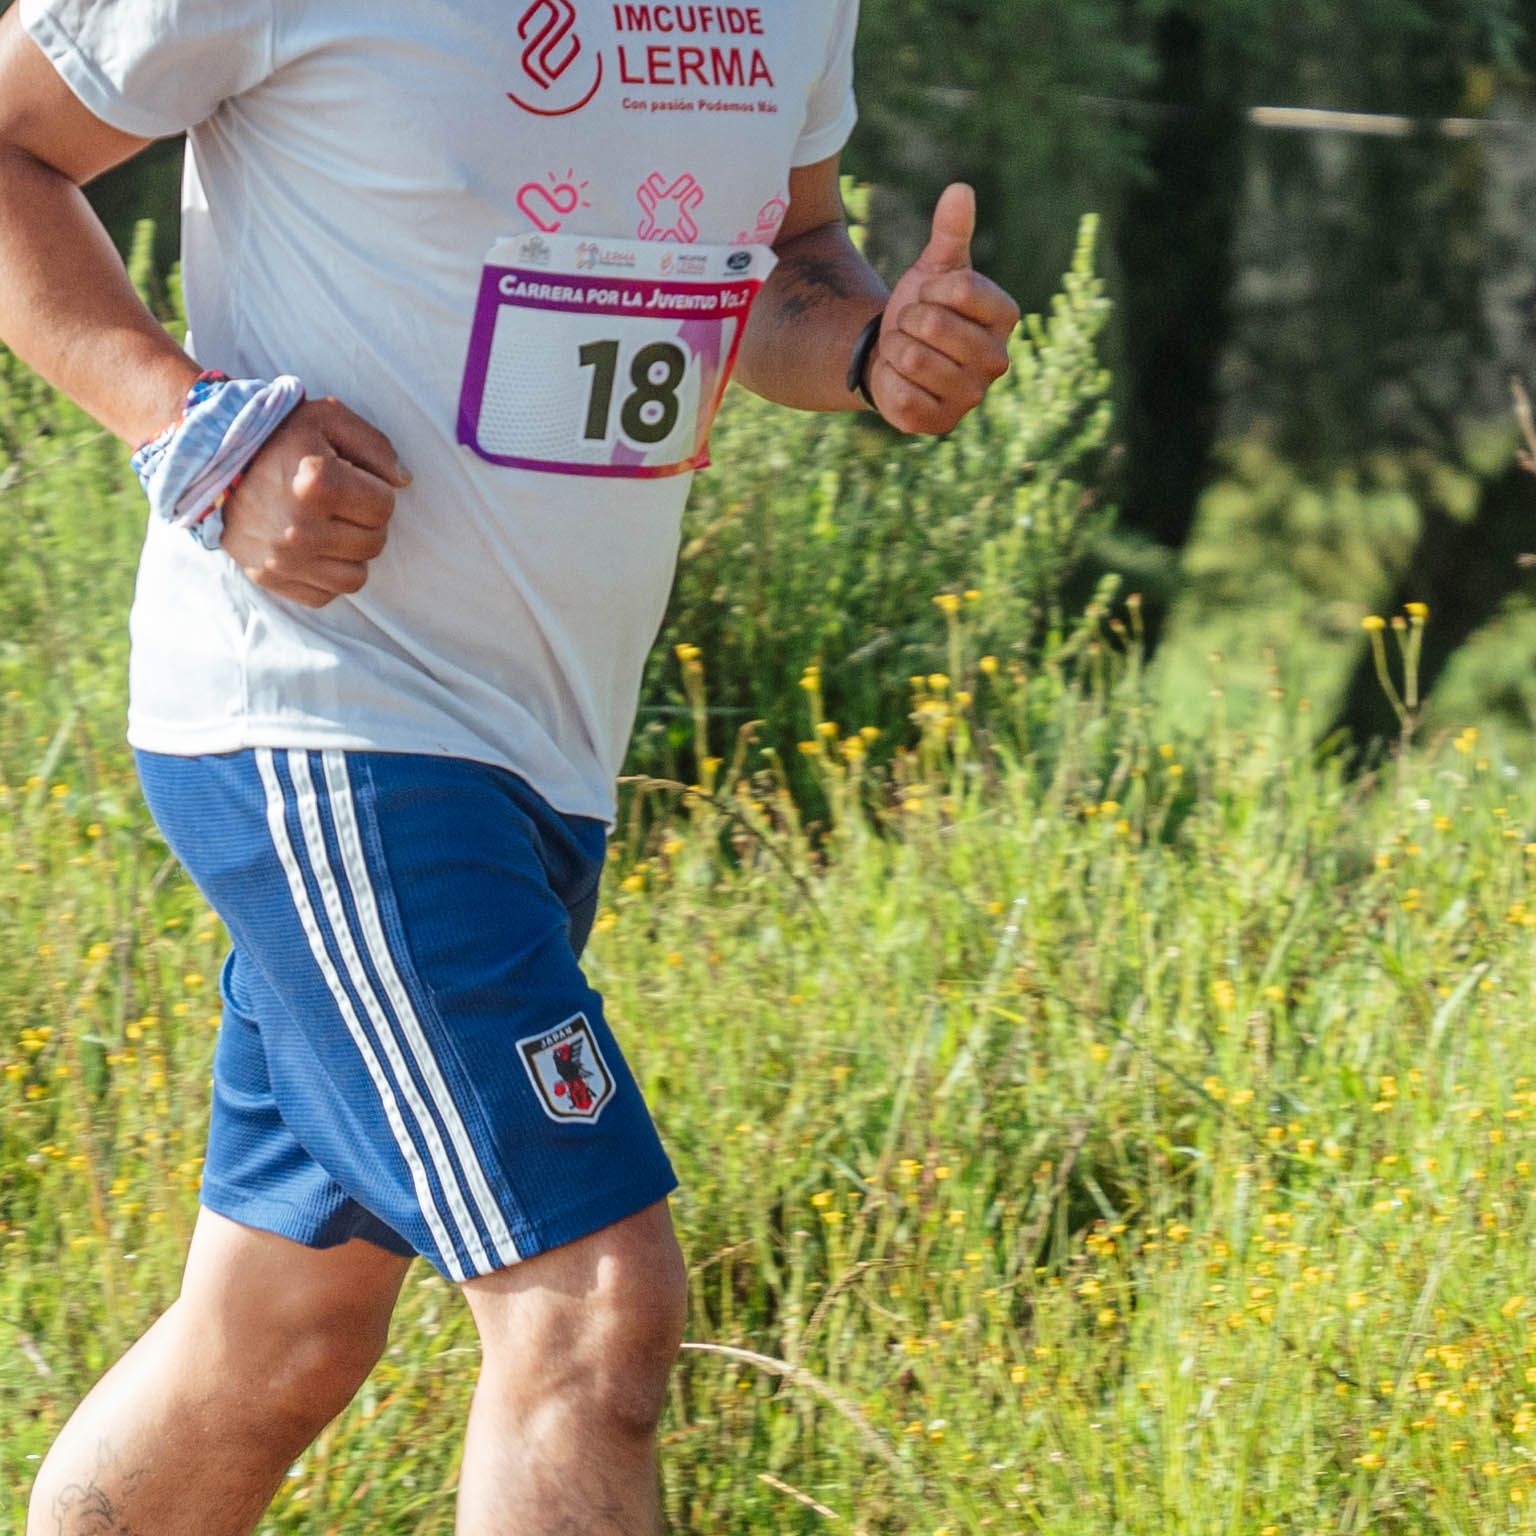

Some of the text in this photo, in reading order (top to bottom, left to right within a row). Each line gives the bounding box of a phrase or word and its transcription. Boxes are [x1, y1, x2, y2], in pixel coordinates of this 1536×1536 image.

[612, 4, 764, 35] IMCUFIDE
[618, 44, 774, 88] LERMA
[622, 97, 647, 111] Con
[698, 98, 754, 113] Podemos
[498, 274, 584, 304] CARRERA
[621, 290, 643, 307] LA
[578, 340, 686, 444] 18
[540, 1025, 573, 1049] JAPAN
